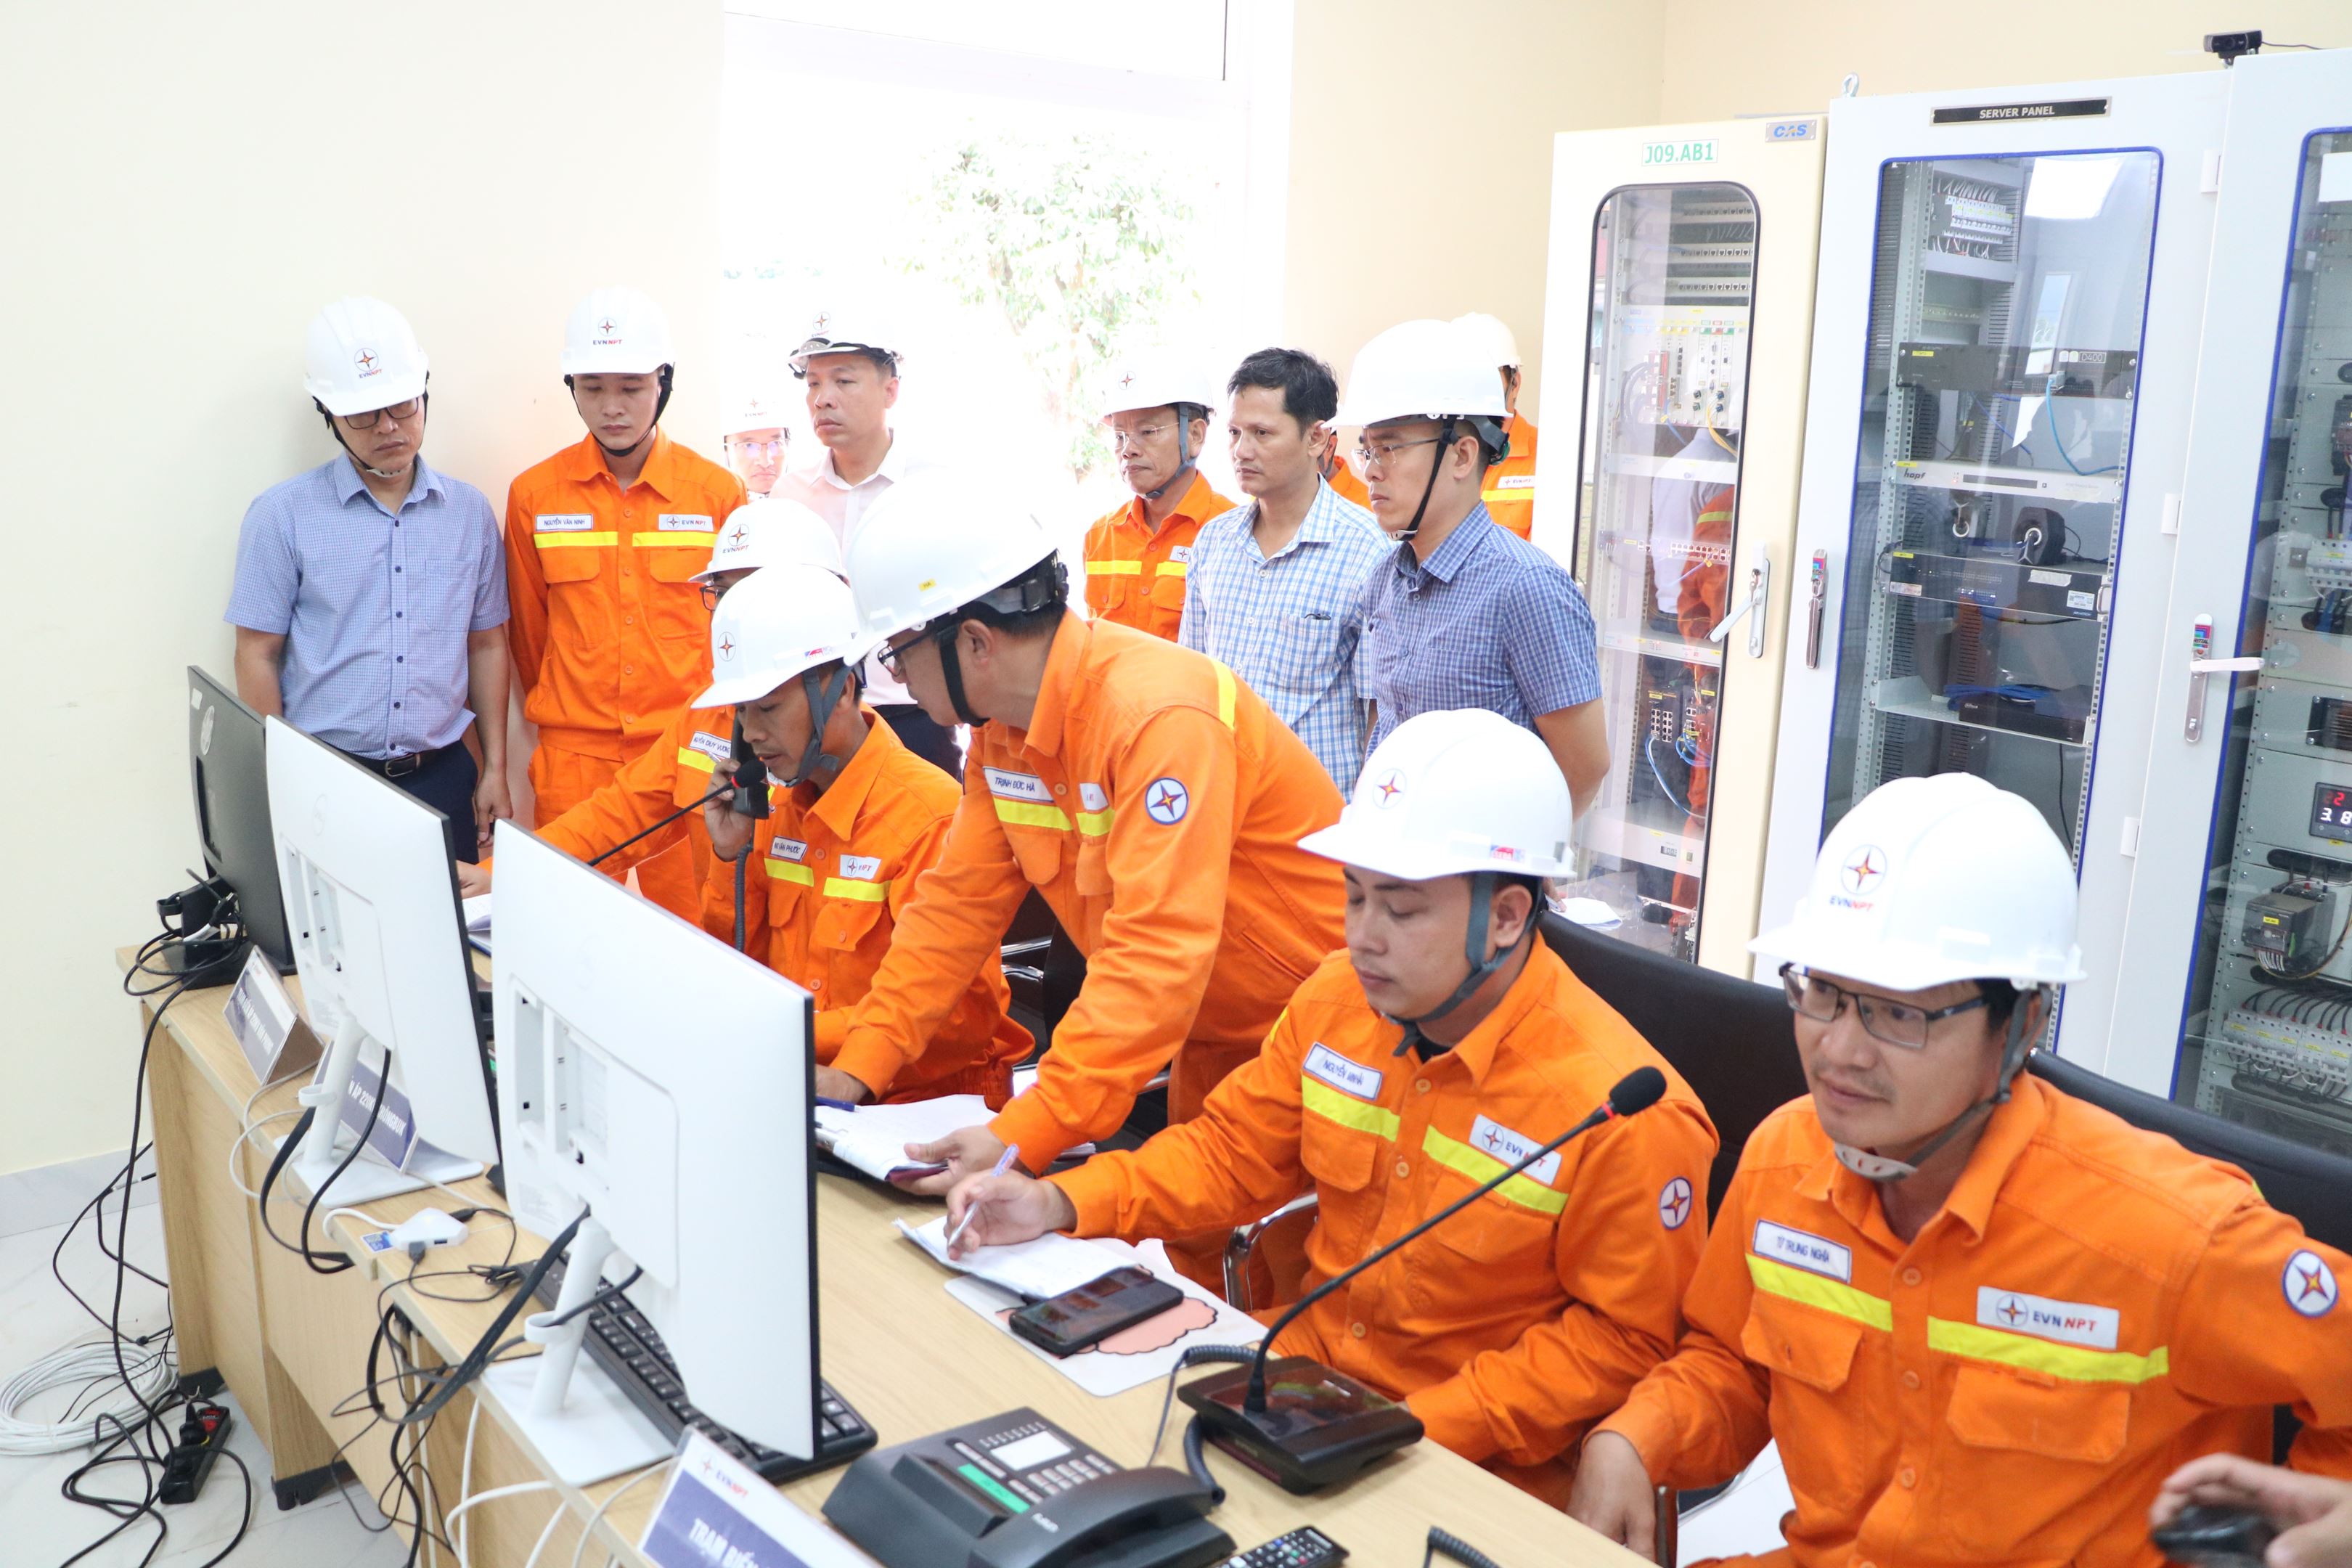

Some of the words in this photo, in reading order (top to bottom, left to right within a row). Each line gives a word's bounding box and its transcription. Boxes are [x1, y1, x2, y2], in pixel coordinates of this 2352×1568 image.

[1979, 107, 2019, 118] SERVER
[2021, 105, 2055, 116] PANEL
[1644, 142, 1714, 163] J09.AB1
[359, 368, 383, 379] EVNNPT
[1904, 467, 1927, 480] hopf
[722, 544, 750, 554] EVNNPT
[688, 1517, 729, 1561] TRẠM
